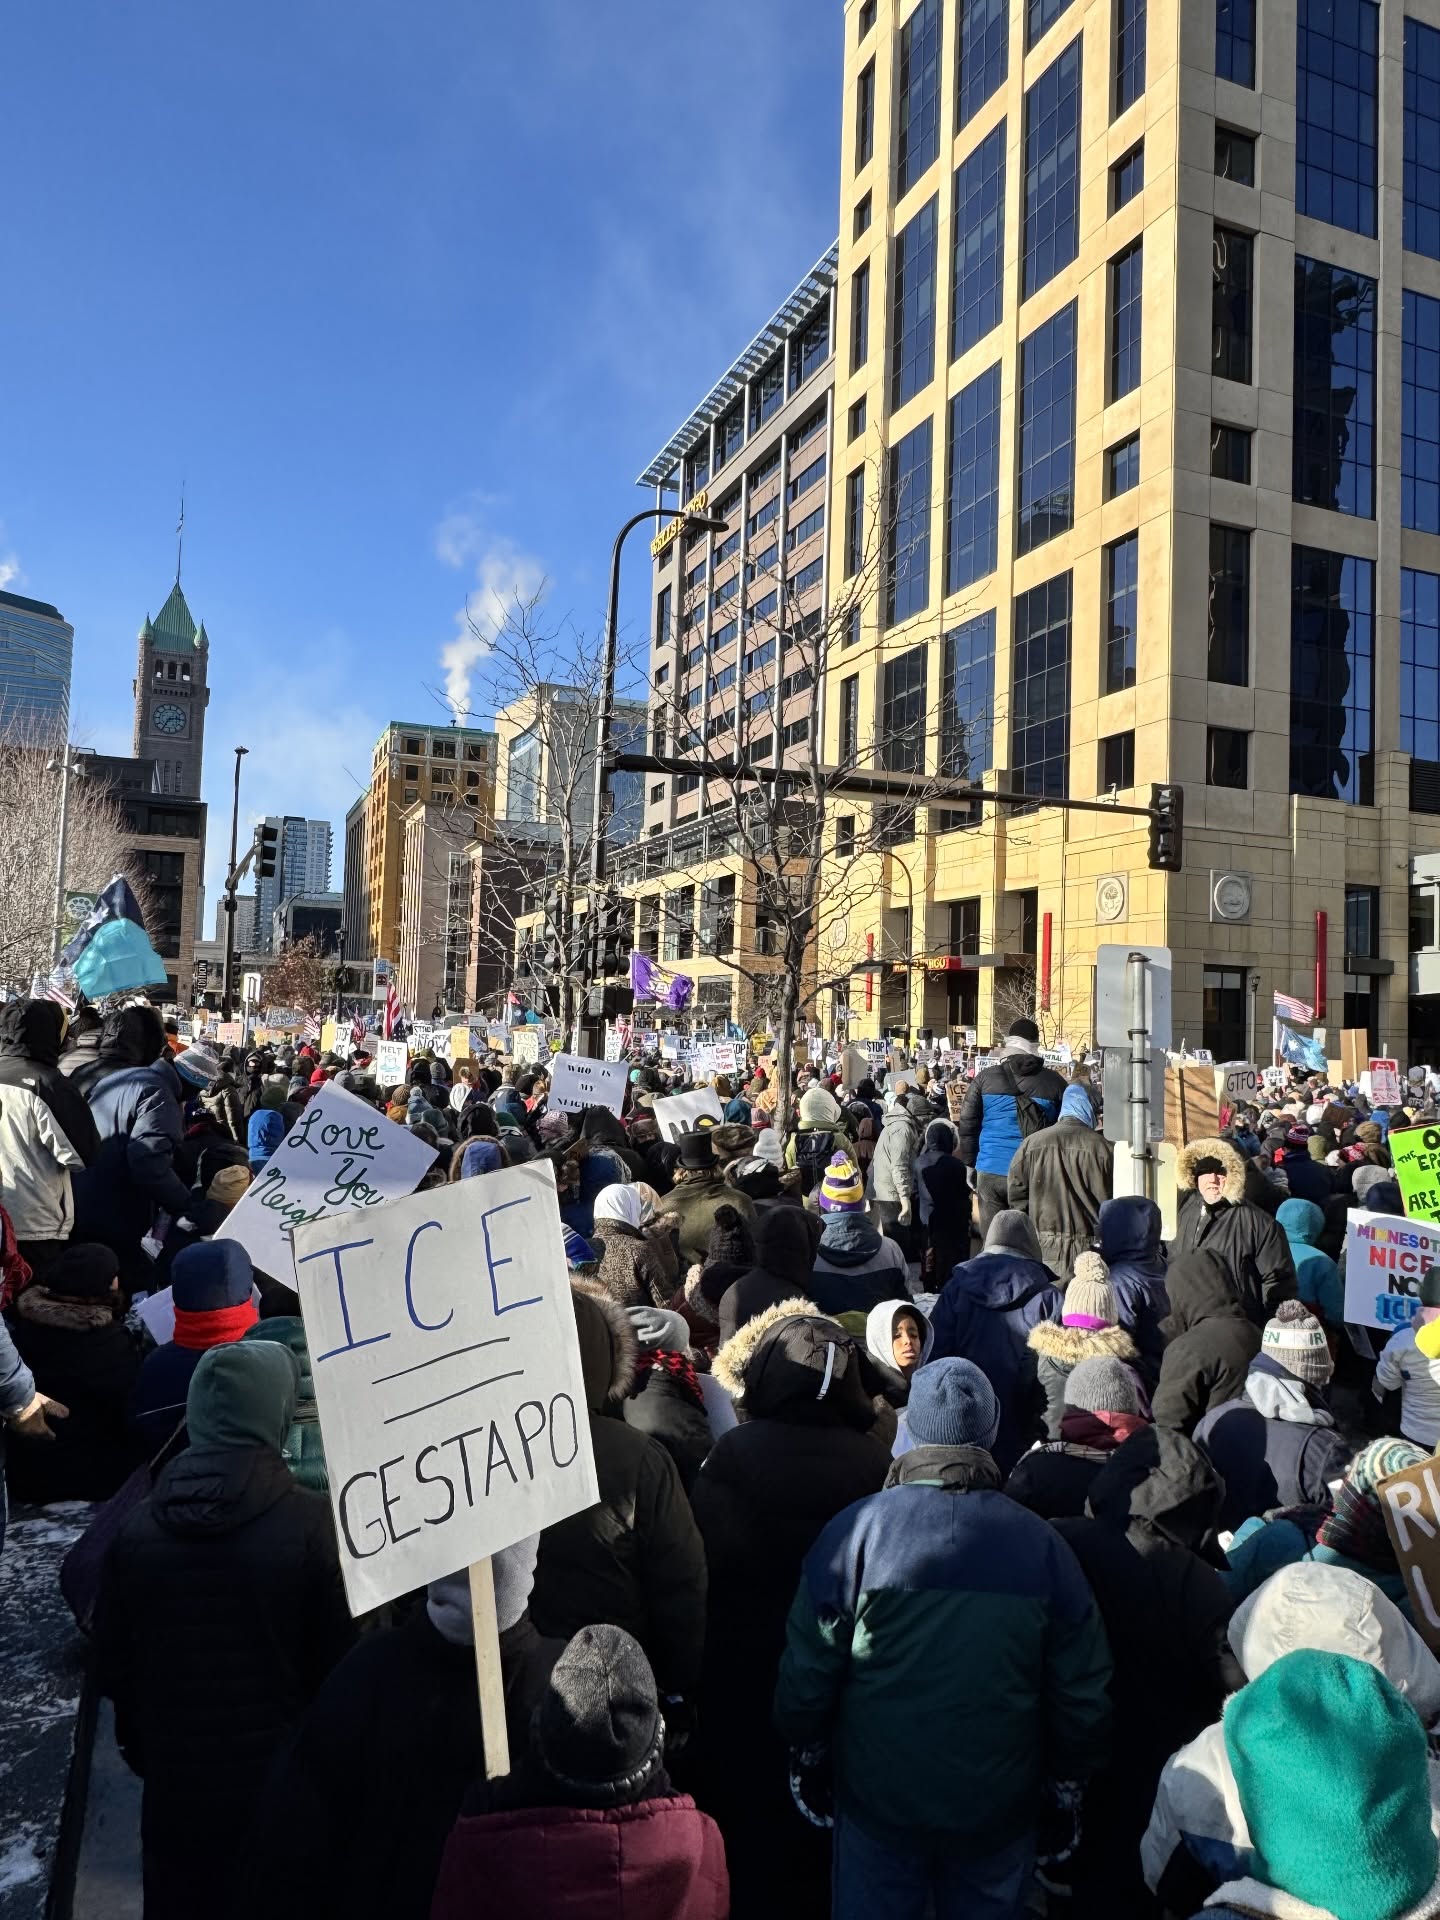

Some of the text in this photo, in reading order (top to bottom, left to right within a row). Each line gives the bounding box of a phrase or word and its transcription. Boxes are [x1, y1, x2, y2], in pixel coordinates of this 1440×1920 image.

[380, 1045, 402, 1056] MELT
[417, 1033, 448, 1054] NOW
[866, 1041, 885, 1053] STOP
[567, 1064, 612, 1077] WHO IS
[1227, 1070, 1256, 1092] GTFO
[579, 1083, 595, 1092] MY
[949, 1084, 967, 1096] ICE
[287, 1108, 385, 1154] Love
[1422, 1128, 1440, 1151] O
[1397, 1150, 1418, 1164] THE
[1416, 1152, 1440, 1172] EP
[248, 1166, 327, 1232] Neig
[1408, 1189, 1440, 1212] ARE
[1356, 1223, 1440, 1254] MINNESOT
[1368, 1245, 1435, 1275] NICE
[297, 1195, 544, 1363] ICE
[338, 1392, 579, 1560] GESTAPO
